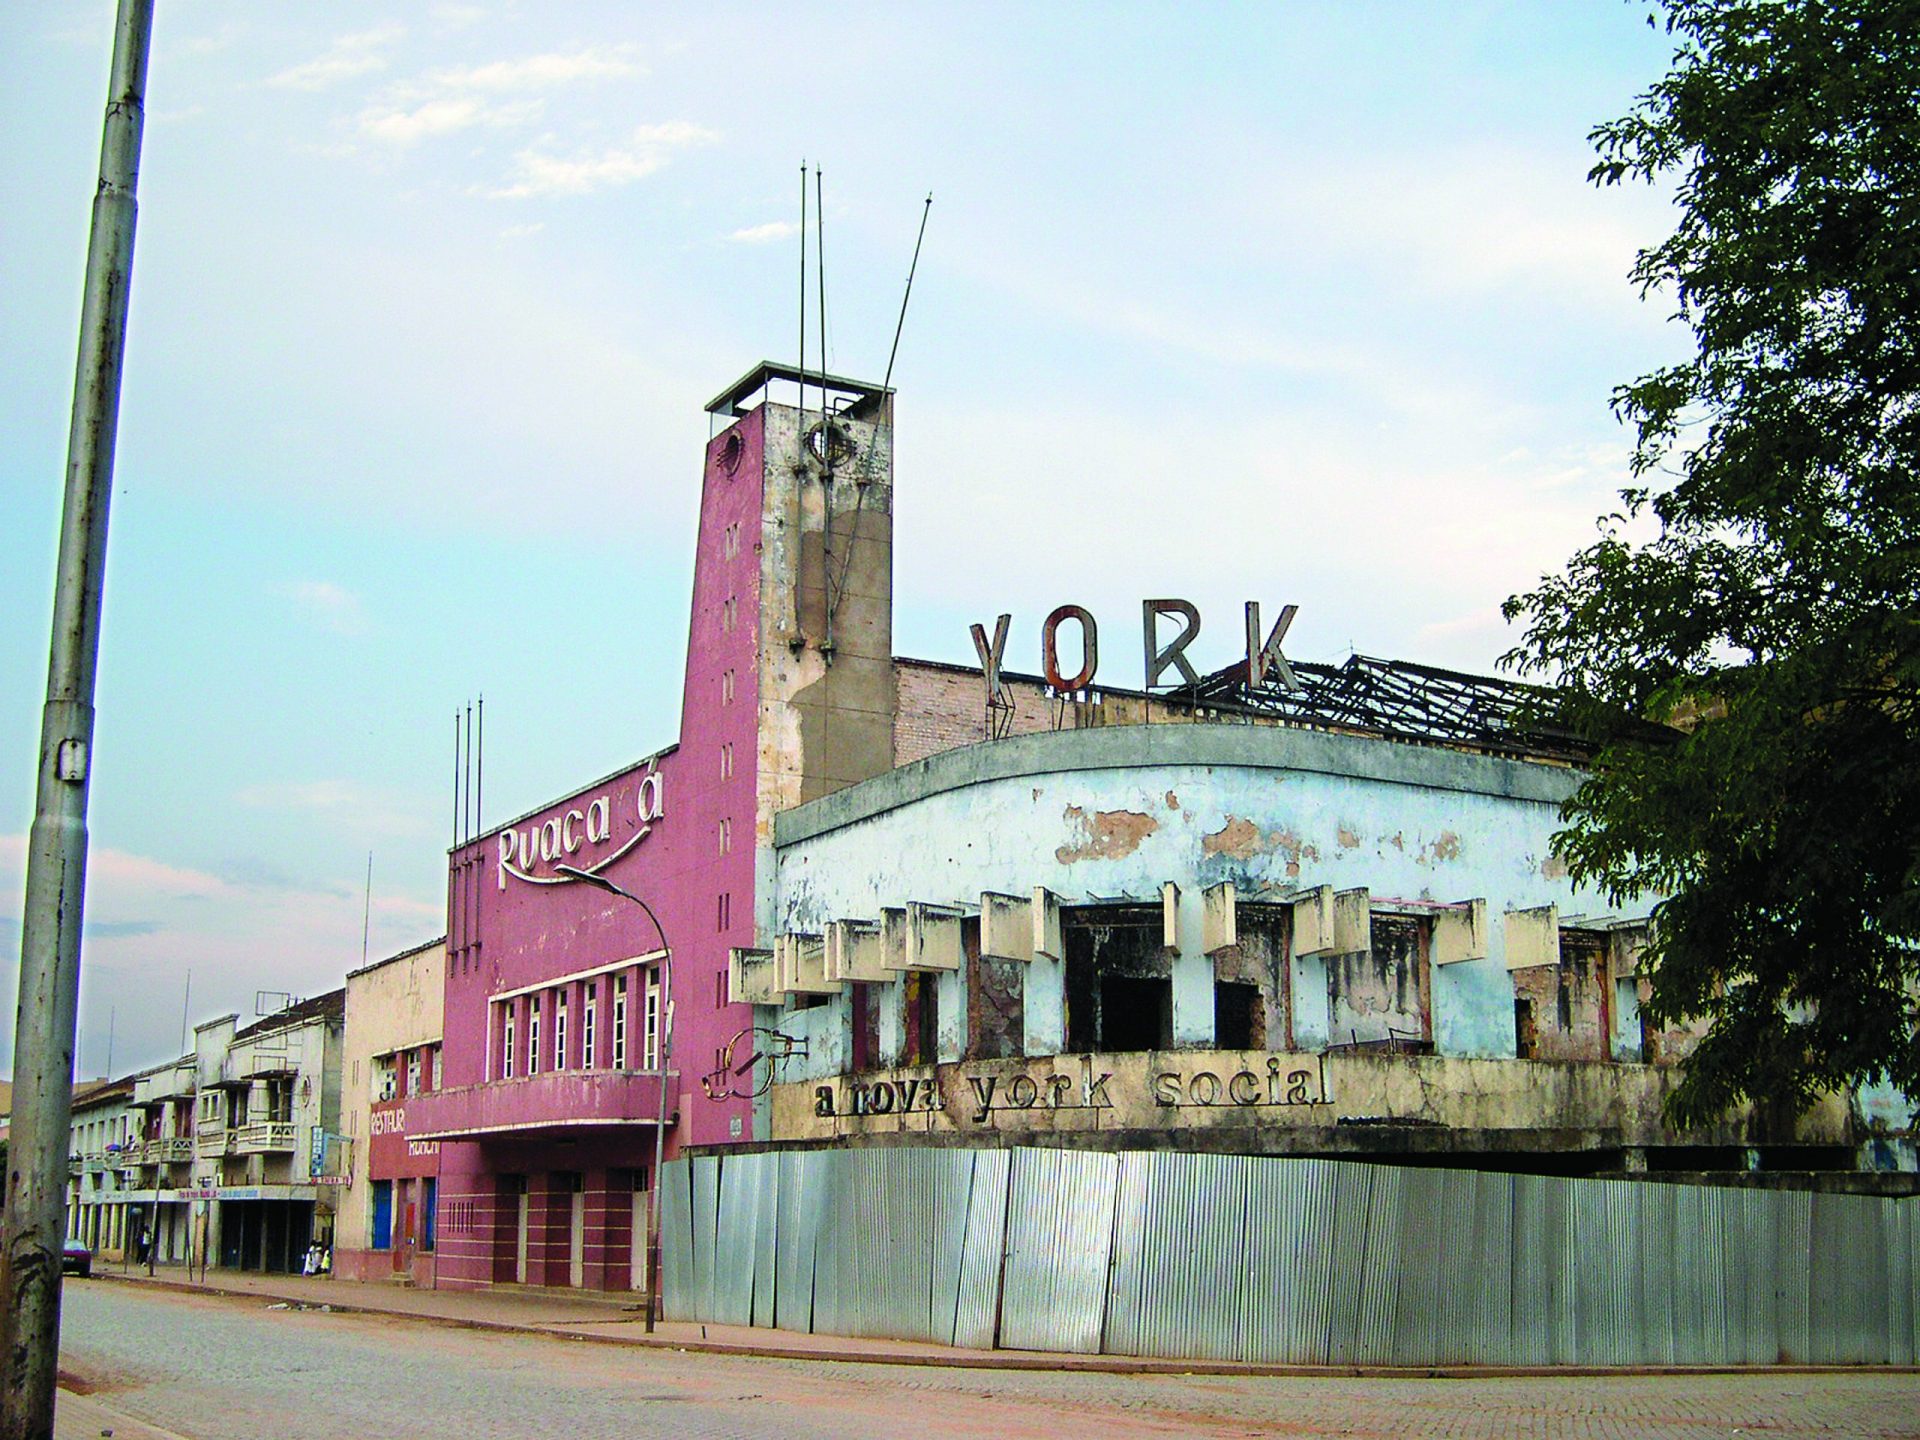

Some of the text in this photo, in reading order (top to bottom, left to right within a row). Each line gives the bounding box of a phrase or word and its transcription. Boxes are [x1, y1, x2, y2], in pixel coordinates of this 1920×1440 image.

[969, 598, 1300, 706] YORK
[814, 1050, 1336, 1124] a nova york social
